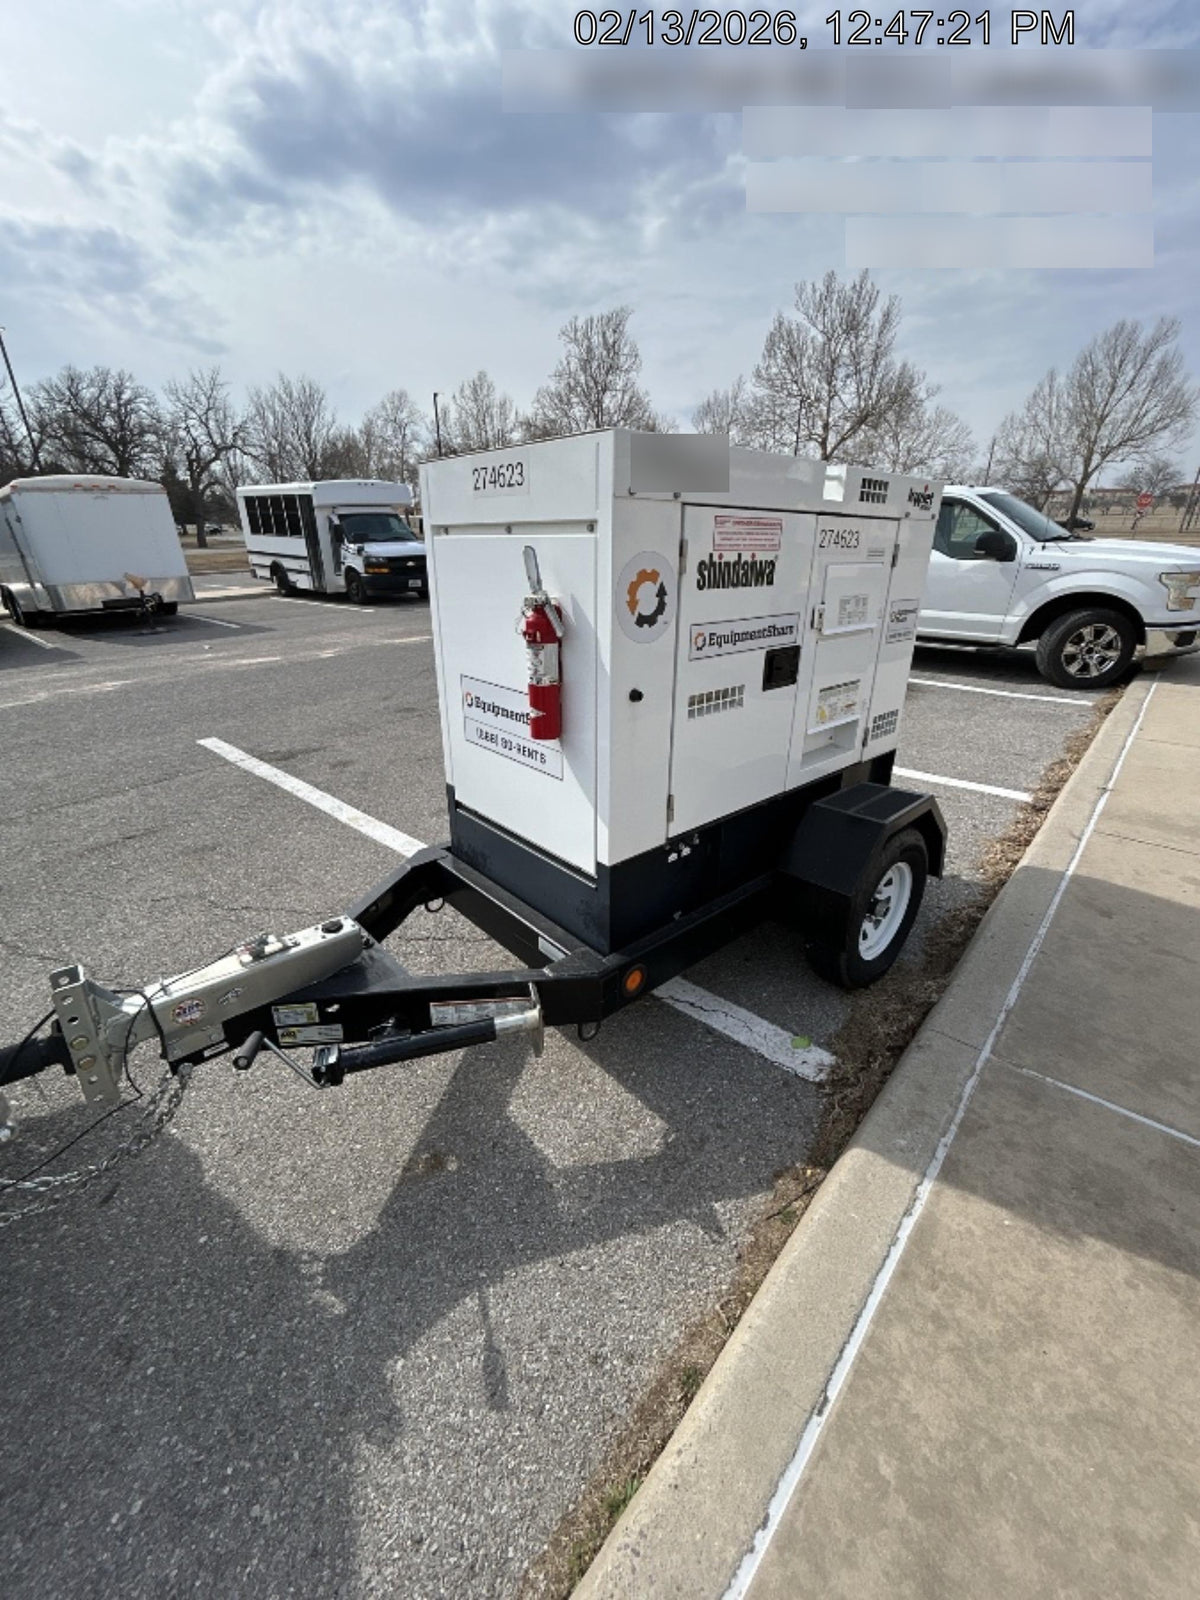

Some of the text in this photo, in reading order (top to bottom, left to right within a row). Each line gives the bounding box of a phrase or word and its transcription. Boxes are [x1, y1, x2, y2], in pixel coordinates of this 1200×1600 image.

[472, 461, 525, 491] 274623
[819, 529, 860, 549] 274623
[696, 552, 776, 591] shindaiwa
